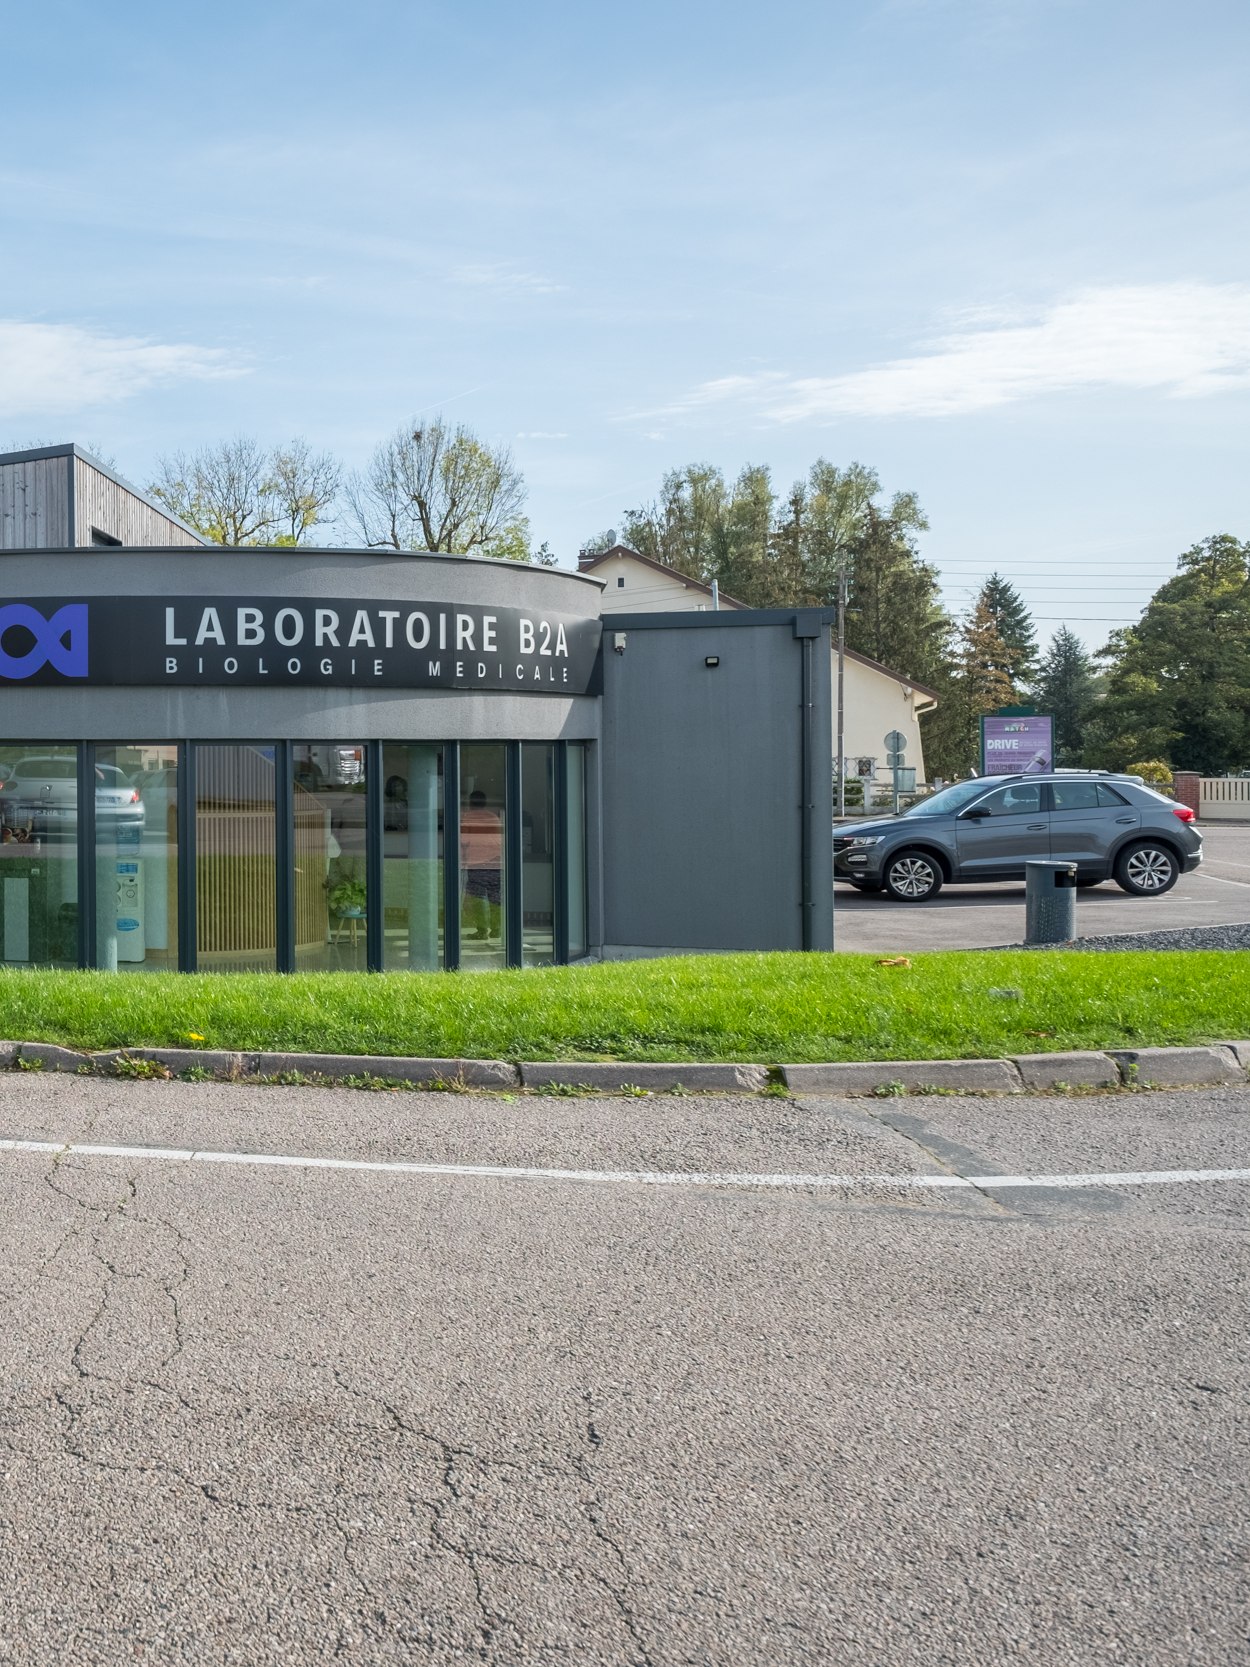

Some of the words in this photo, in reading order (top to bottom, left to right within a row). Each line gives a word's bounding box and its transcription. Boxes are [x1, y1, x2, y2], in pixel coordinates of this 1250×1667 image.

[165, 606, 498, 652] LABORATOIRE
[519, 617, 569, 658] B2A
[165, 656, 383, 676] BIOLOGIE
[428, 660, 568, 682] MEDICALE
[987, 739, 1019, 749] DRIVE
